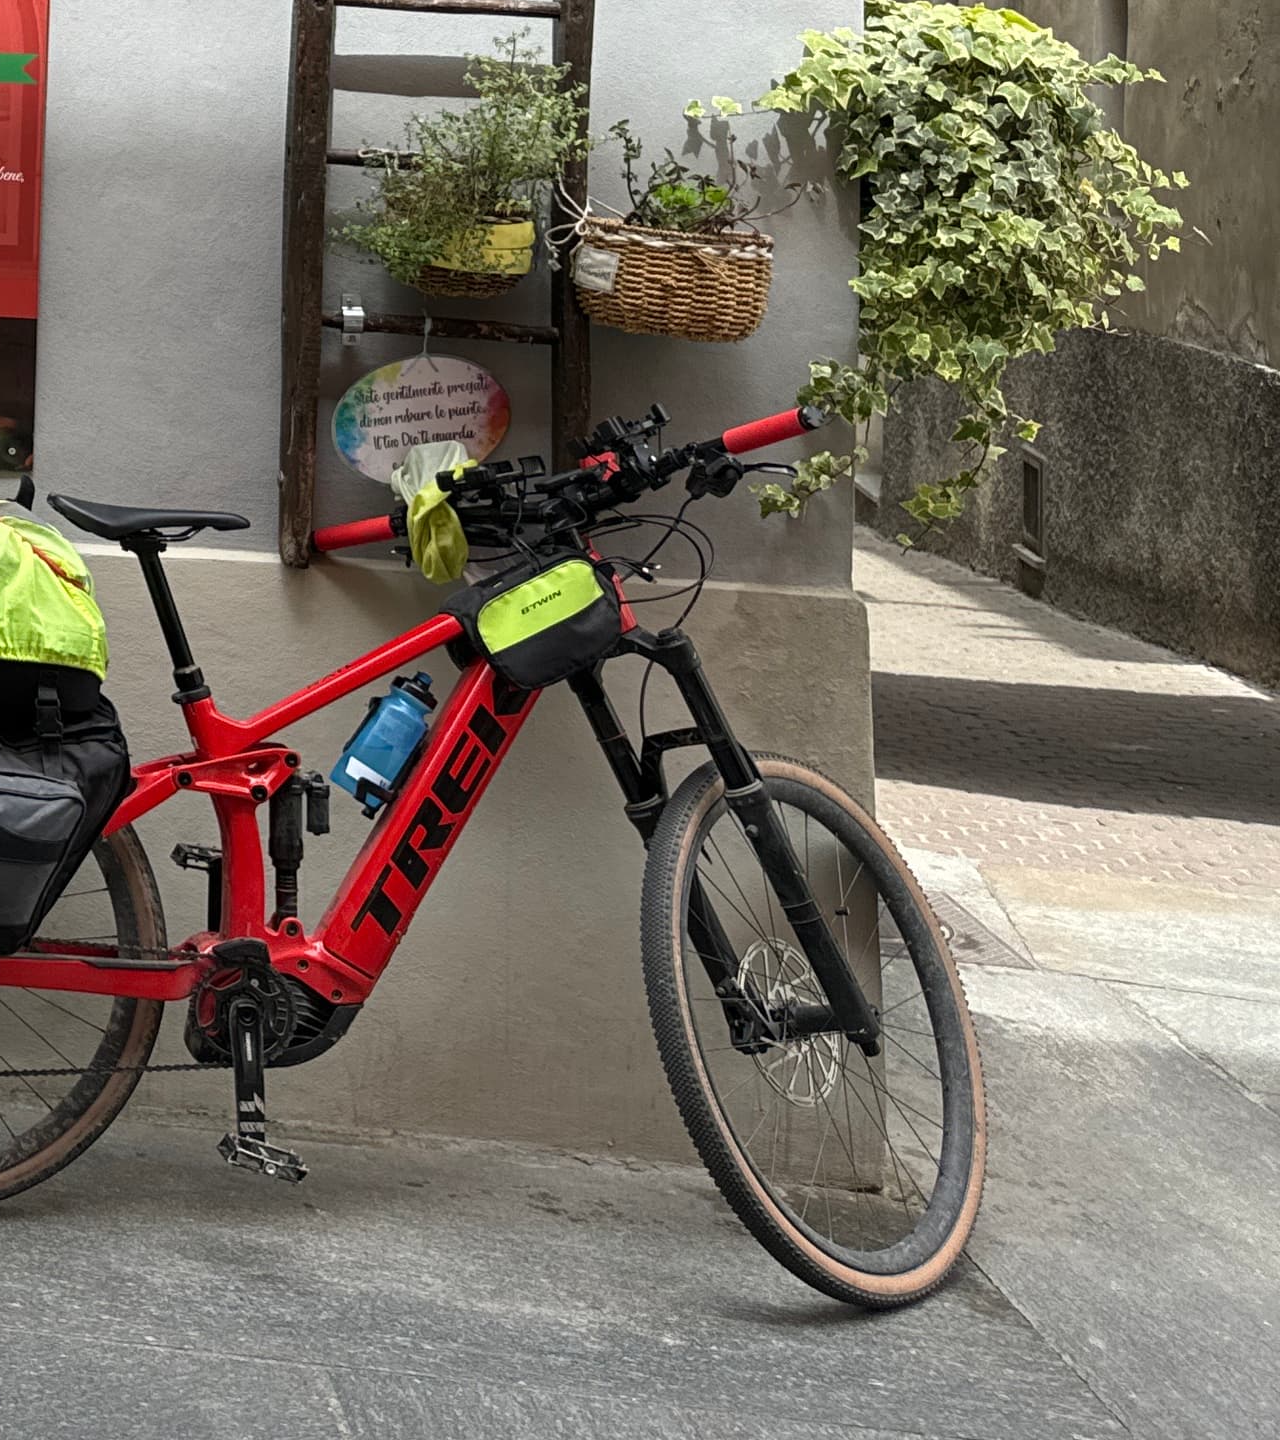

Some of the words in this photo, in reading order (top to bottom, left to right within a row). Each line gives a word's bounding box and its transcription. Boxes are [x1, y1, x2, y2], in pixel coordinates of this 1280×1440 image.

[383, 381, 445, 405] gentilmente
[447, 376, 490, 397] pregati
[360, 413, 372, 428] di
[373, 415, 392, 427] non
[395, 408, 434, 424] rubare
[434, 404, 446, 419] le
[373, 435, 382, 450] Il
[382, 435, 400, 449] tuo
[401, 432, 419, 447] Dio
[351, 674, 532, 935] TREK
